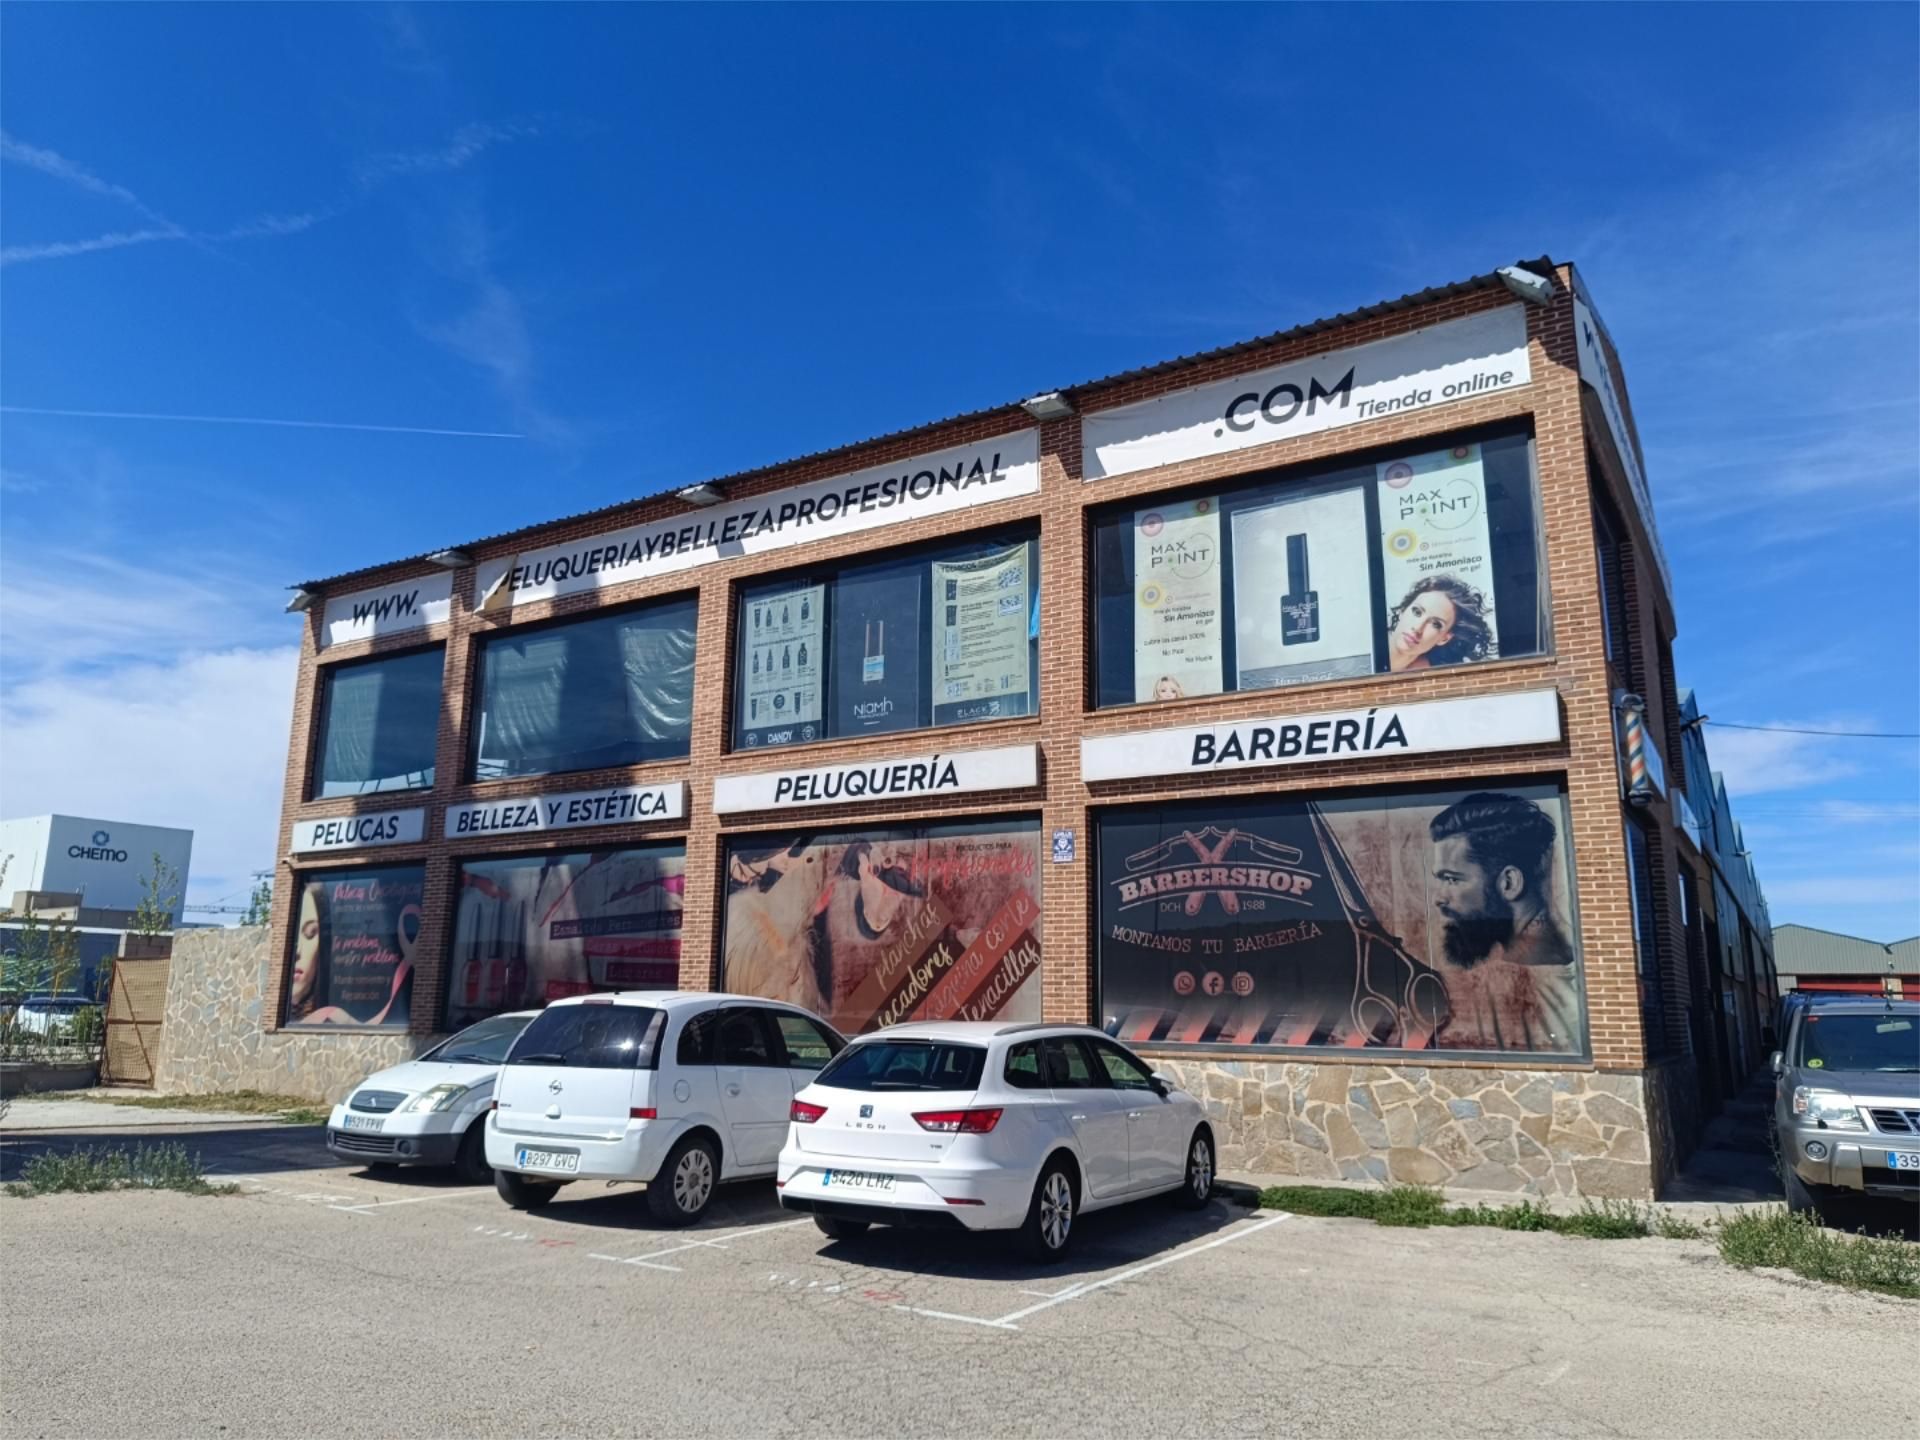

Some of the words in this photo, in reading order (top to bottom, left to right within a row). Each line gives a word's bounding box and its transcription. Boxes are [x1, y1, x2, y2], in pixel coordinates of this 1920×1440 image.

[1213, 365, 1356, 439] .COM
[1356, 389, 1432, 419] Tienda
[1442, 367, 1514, 399] online
[1399, 488, 1442, 506] MAX
[1151, 541, 1187, 555] MAX
[1419, 562, 1434, 571] Sin
[767, 730, 793, 744] DANDY
[1190, 708, 1409, 766] BARBERÍA
[774, 754, 960, 803] PELUQUERÍA
[456, 805, 539, 833] BELLEZA
[546, 801, 561, 825] Y
[567, 789, 668, 823] ESTÉTICA
[311, 815, 400, 847] PELUCAS
[67, 845, 128, 863] CHEMO
[1118, 867, 1313, 902] BARBERSHOP
[1160, 901, 1181, 913] DCH
[1242, 900, 1266, 912] 1988
[875, 903, 941, 992] planchas
[1111, 925, 1192, 953] MONTAMOS
[1202, 938, 1224, 954] TU
[1233, 920, 1323, 953] BARBERÍA
[526, 1151, 552, 1167] 8297
[554, 1153, 576, 1169] GVC
[831, 1169, 864, 1187] 5420
[865, 1171, 893, 1190] LHZ
